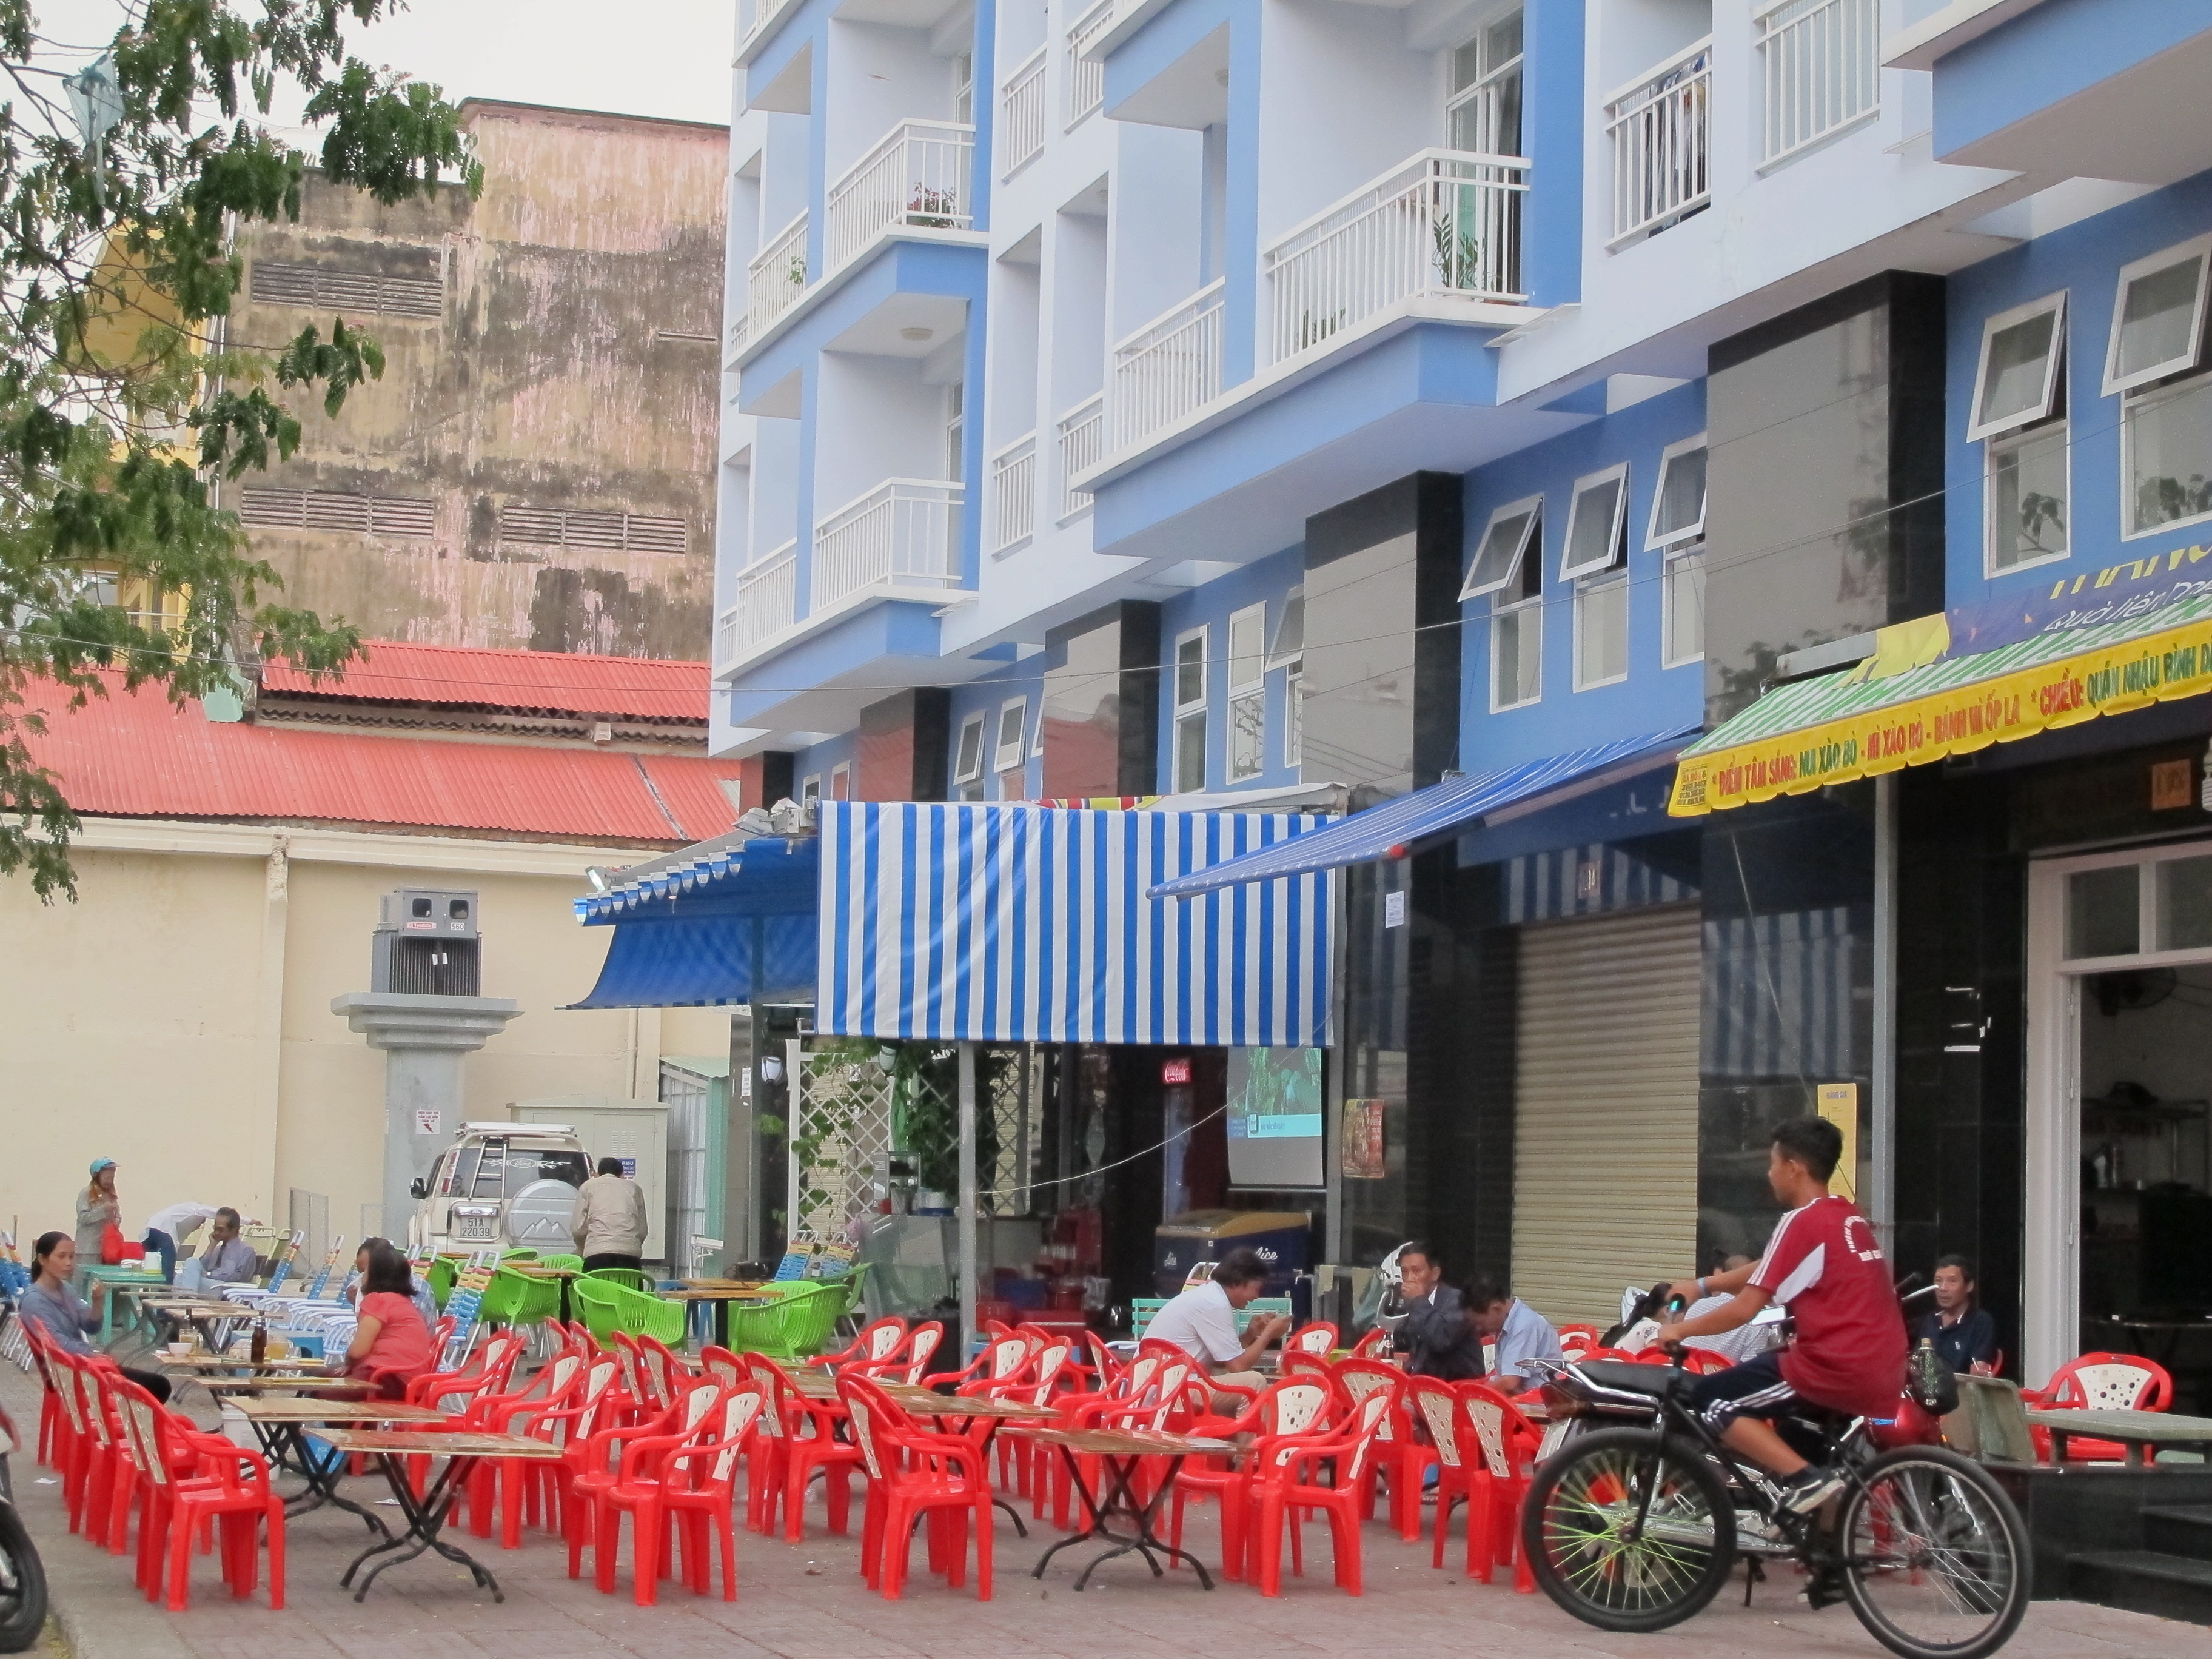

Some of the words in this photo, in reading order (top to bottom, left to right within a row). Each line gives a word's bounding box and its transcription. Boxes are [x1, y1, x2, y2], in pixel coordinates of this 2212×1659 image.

[1744, 756, 1767, 790] TÂM
[1800, 748, 1816, 778] NUI
[1819, 737, 1841, 774] XÀO
[1883, 720, 1906, 758] XÀO
[1935, 705, 1966, 744] BÁNH
[1986, 689, 2002, 731] ỐP
[2005, 694, 2020, 726] LA
[2087, 660, 2120, 708] QUÁN
[2123, 650, 2159, 696] NHẬU
[2163, 643, 2196, 683] BÌNH
[468, 1218, 484, 1227] 51A
[461, 1227, 490, 1237] 220.39
